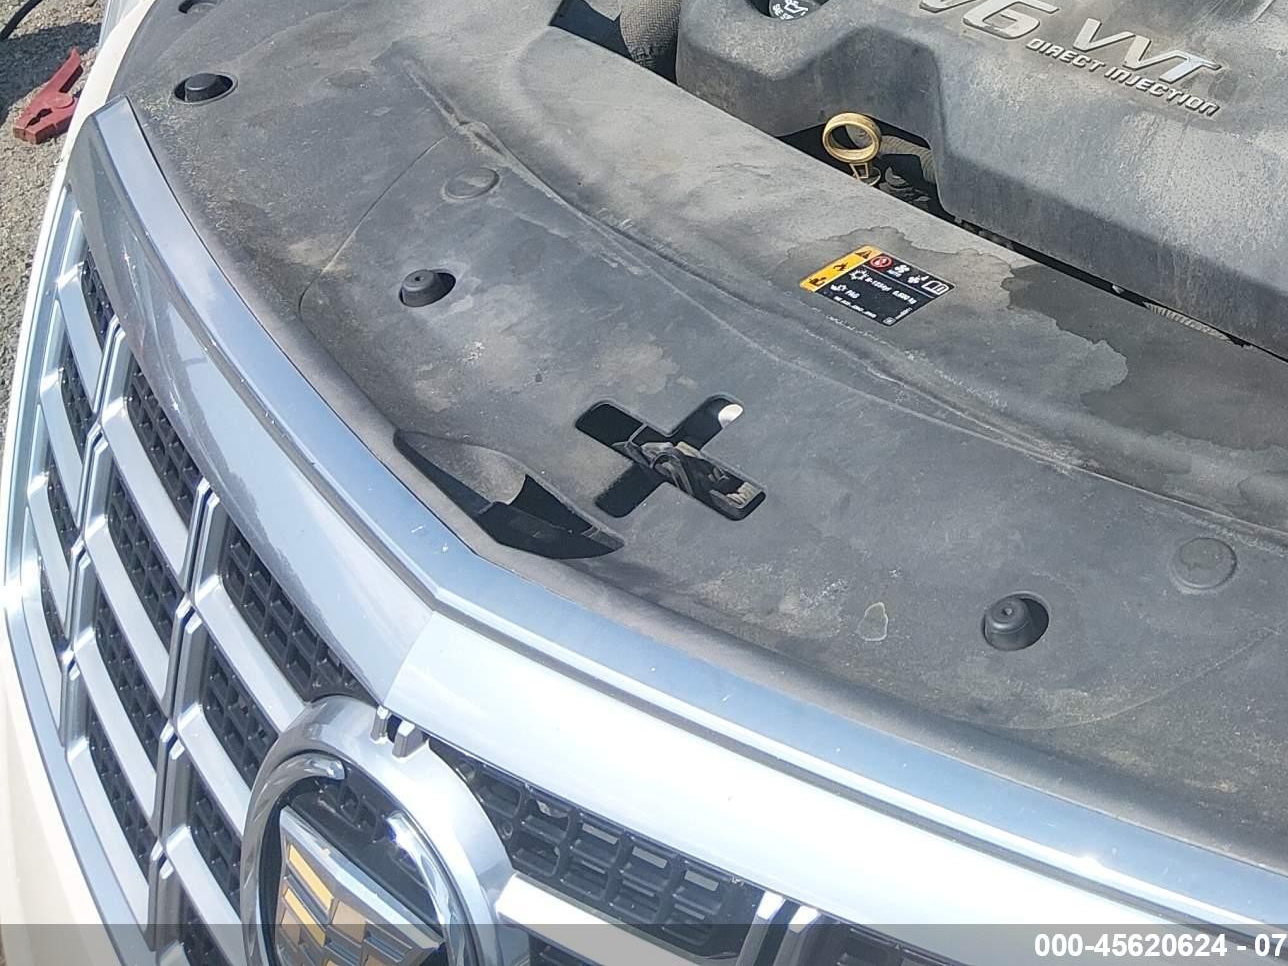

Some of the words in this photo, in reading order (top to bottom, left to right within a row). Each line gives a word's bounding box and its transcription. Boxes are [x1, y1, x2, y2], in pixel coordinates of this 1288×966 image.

[1026, 38, 1106, 71] DIRECT
[1105, 66, 1220, 117] INJECTION
[1073, 18, 1221, 84] VVT
